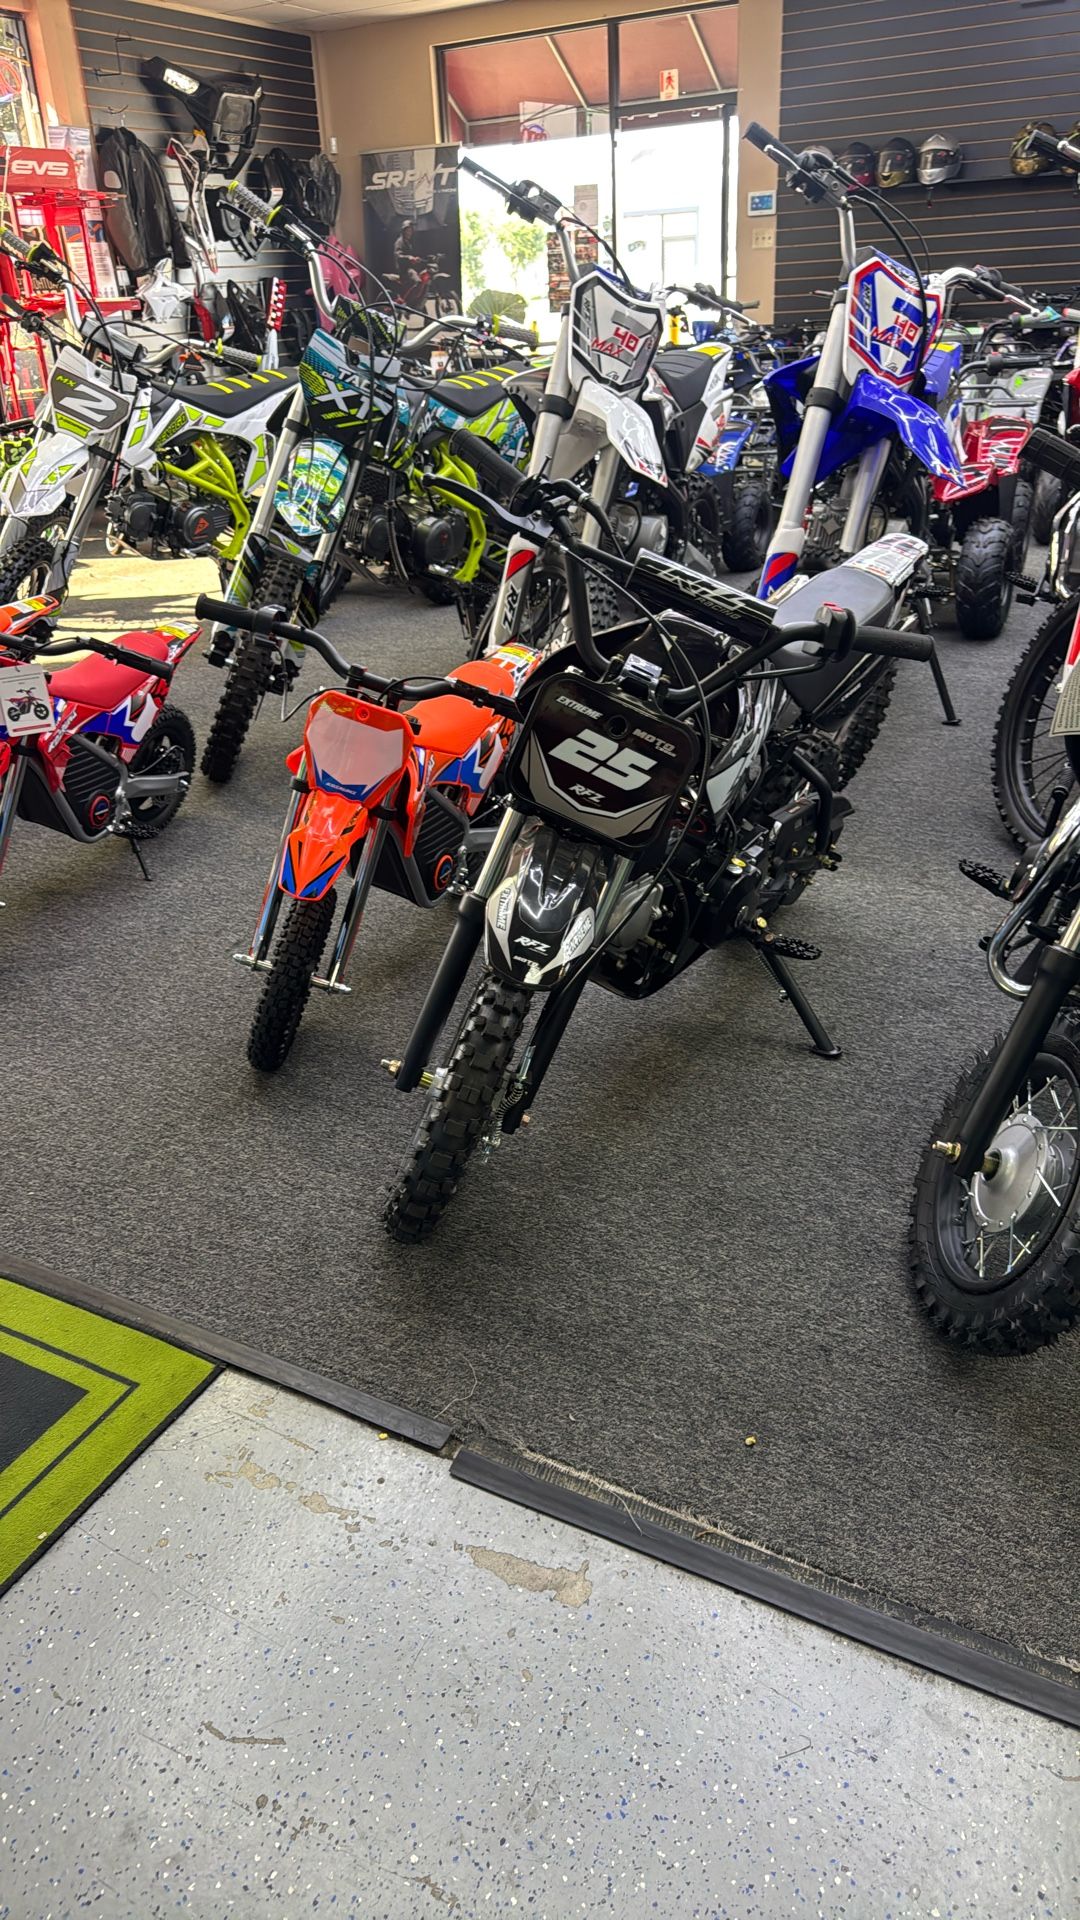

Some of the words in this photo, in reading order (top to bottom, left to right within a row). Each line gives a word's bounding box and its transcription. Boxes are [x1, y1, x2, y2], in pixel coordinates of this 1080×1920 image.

[591, 337, 625, 358] MAX
[613, 327, 640, 353] 40
[55, 375, 77, 387] MX
[58, 384, 117, 423] 2
[501, 581, 521, 636] RFZ
[556, 695, 603, 720] EXTREME
[632, 728, 676, 753] MOTO
[548, 728, 658, 791] 25
[568, 783, 605, 803] RFZ
[513, 935, 551, 952] RFZ
